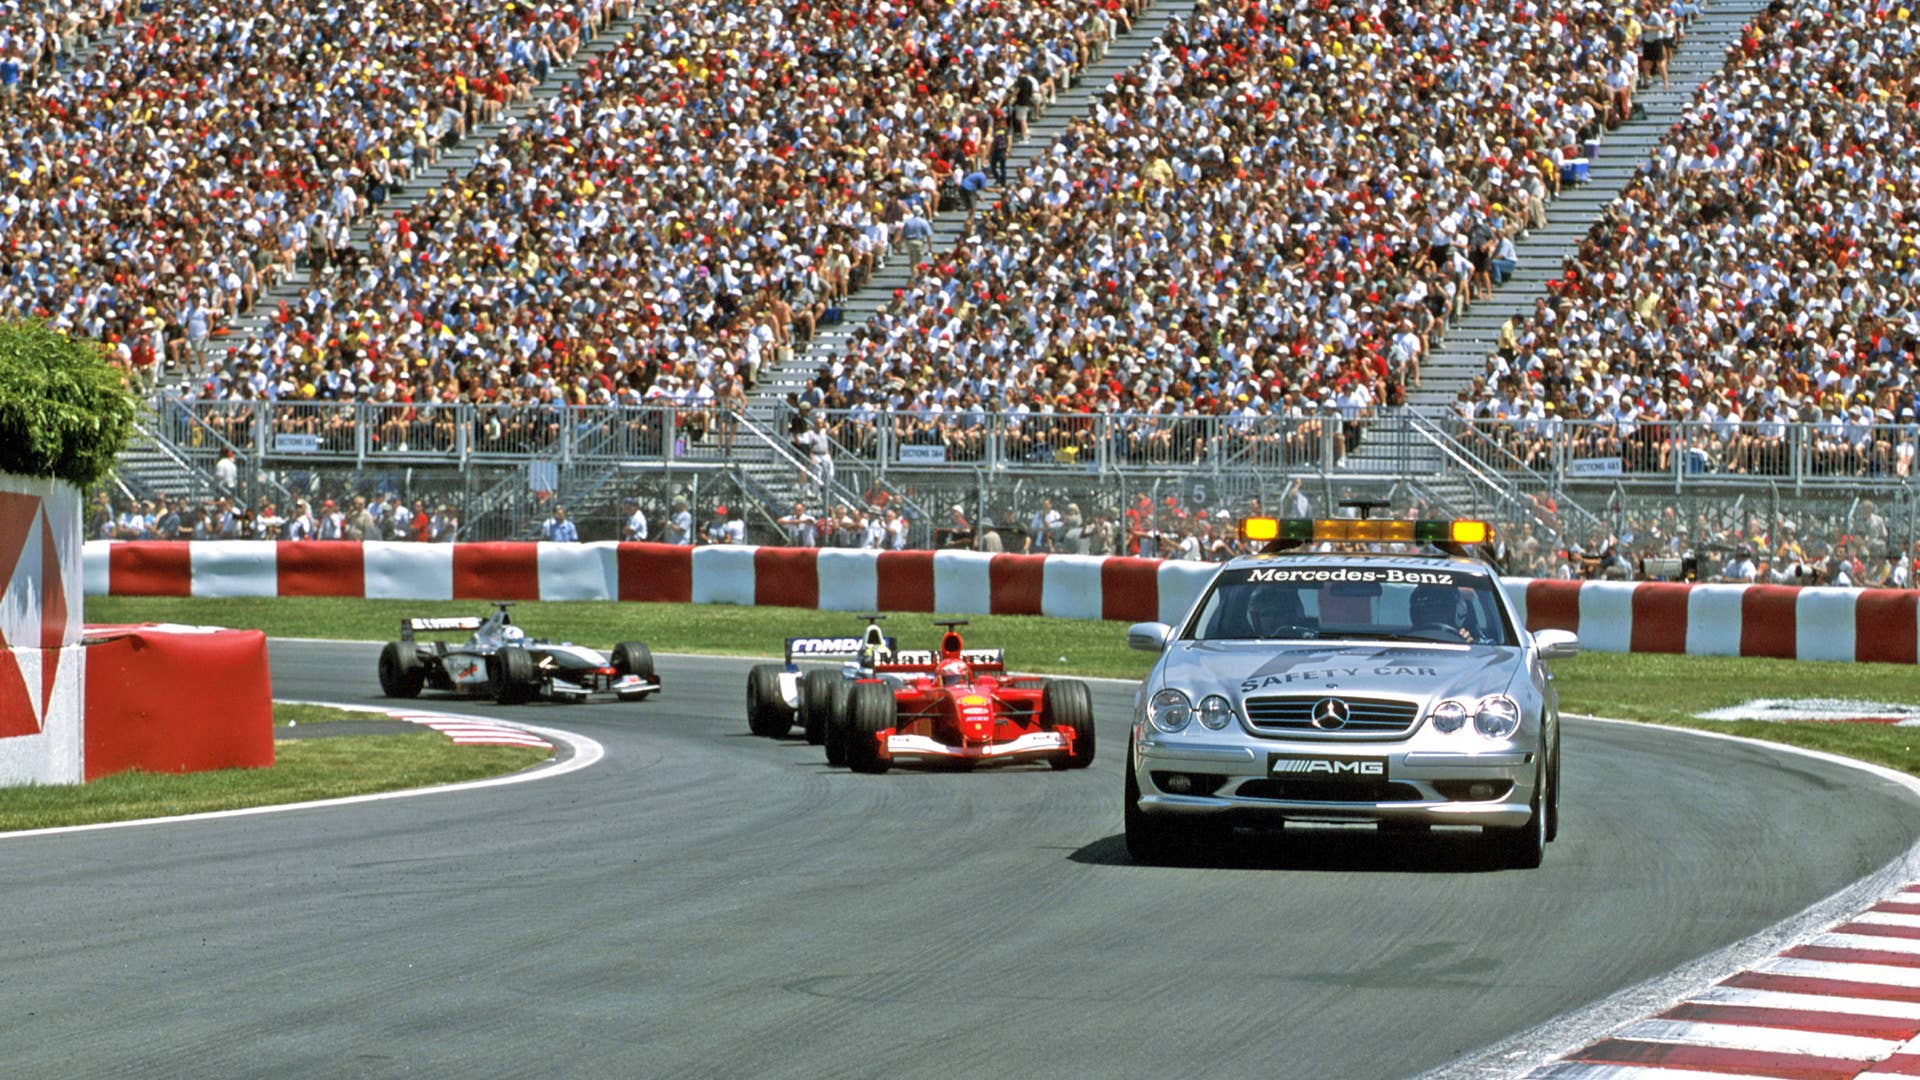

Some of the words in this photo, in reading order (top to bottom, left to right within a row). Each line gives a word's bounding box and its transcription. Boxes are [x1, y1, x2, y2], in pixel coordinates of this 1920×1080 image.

[1574, 462, 1605, 472] SECTIONS
[1193, 484, 1206, 504] 5
[1247, 568, 1453, 585] Mercedes-Benz
[792, 638, 863, 657] COMP
[1240, 667, 1359, 693] SAFETY
[1374, 666, 1437, 677] CAR
[1306, 759, 1383, 775] AMG
